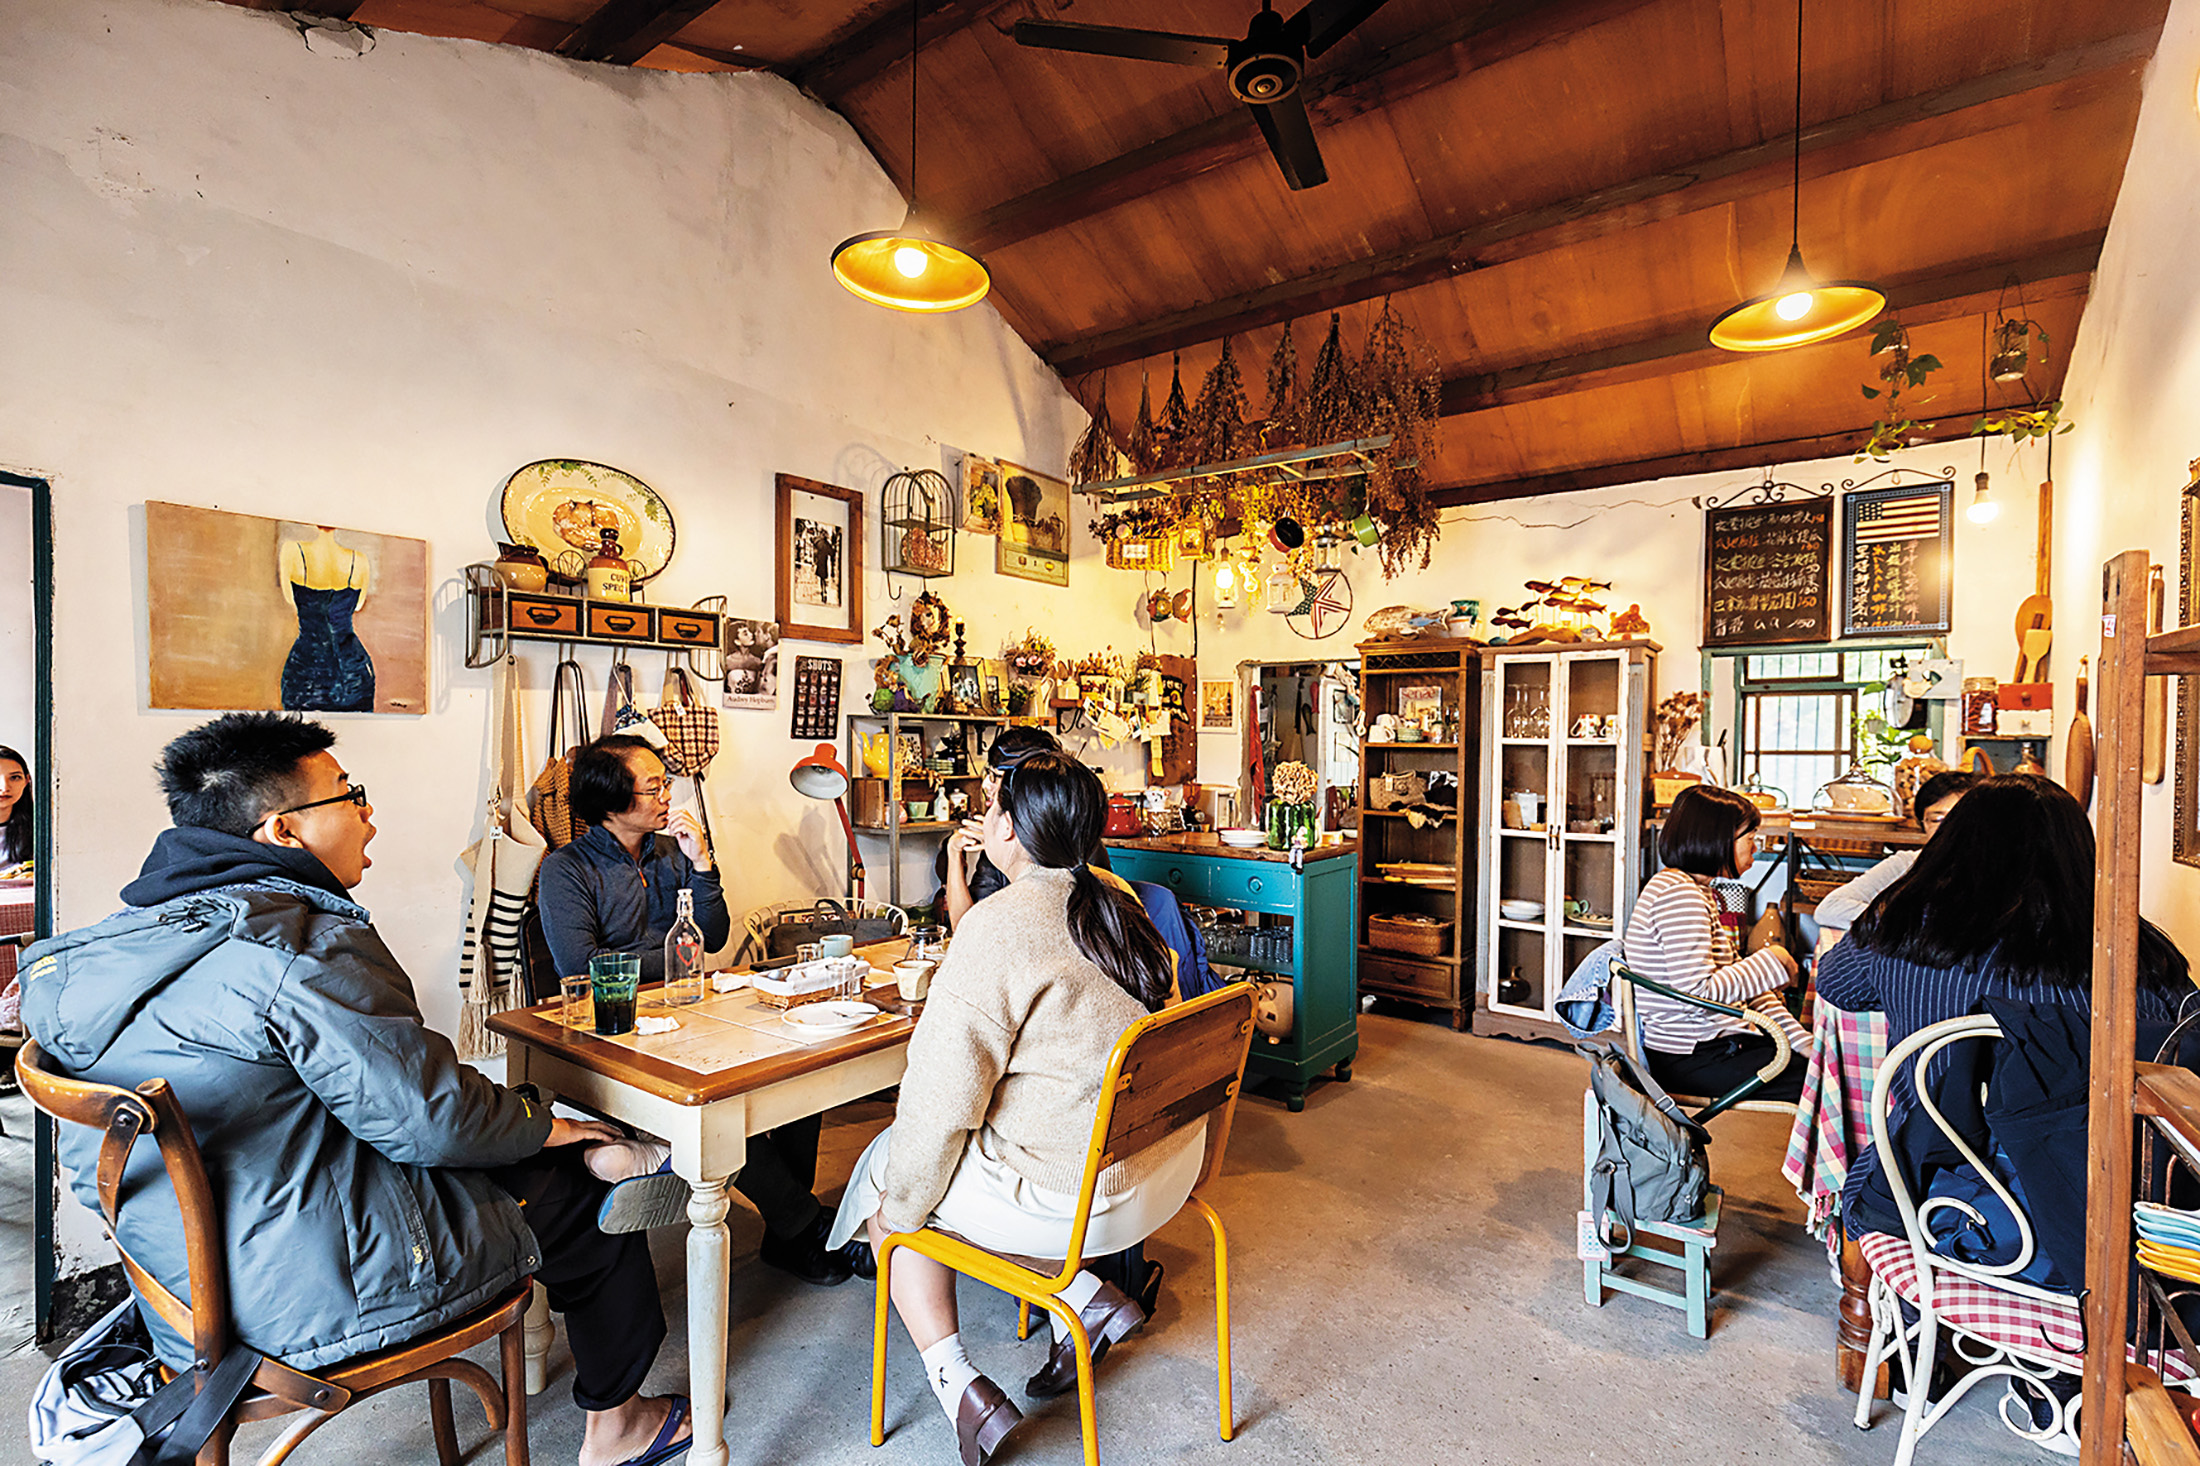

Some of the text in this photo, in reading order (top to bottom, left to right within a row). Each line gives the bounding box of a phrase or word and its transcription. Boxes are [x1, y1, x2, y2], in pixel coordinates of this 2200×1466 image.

[807, 658, 833, 671] SHOTS
[727, 695, 775, 705] Audrey Hepburn
